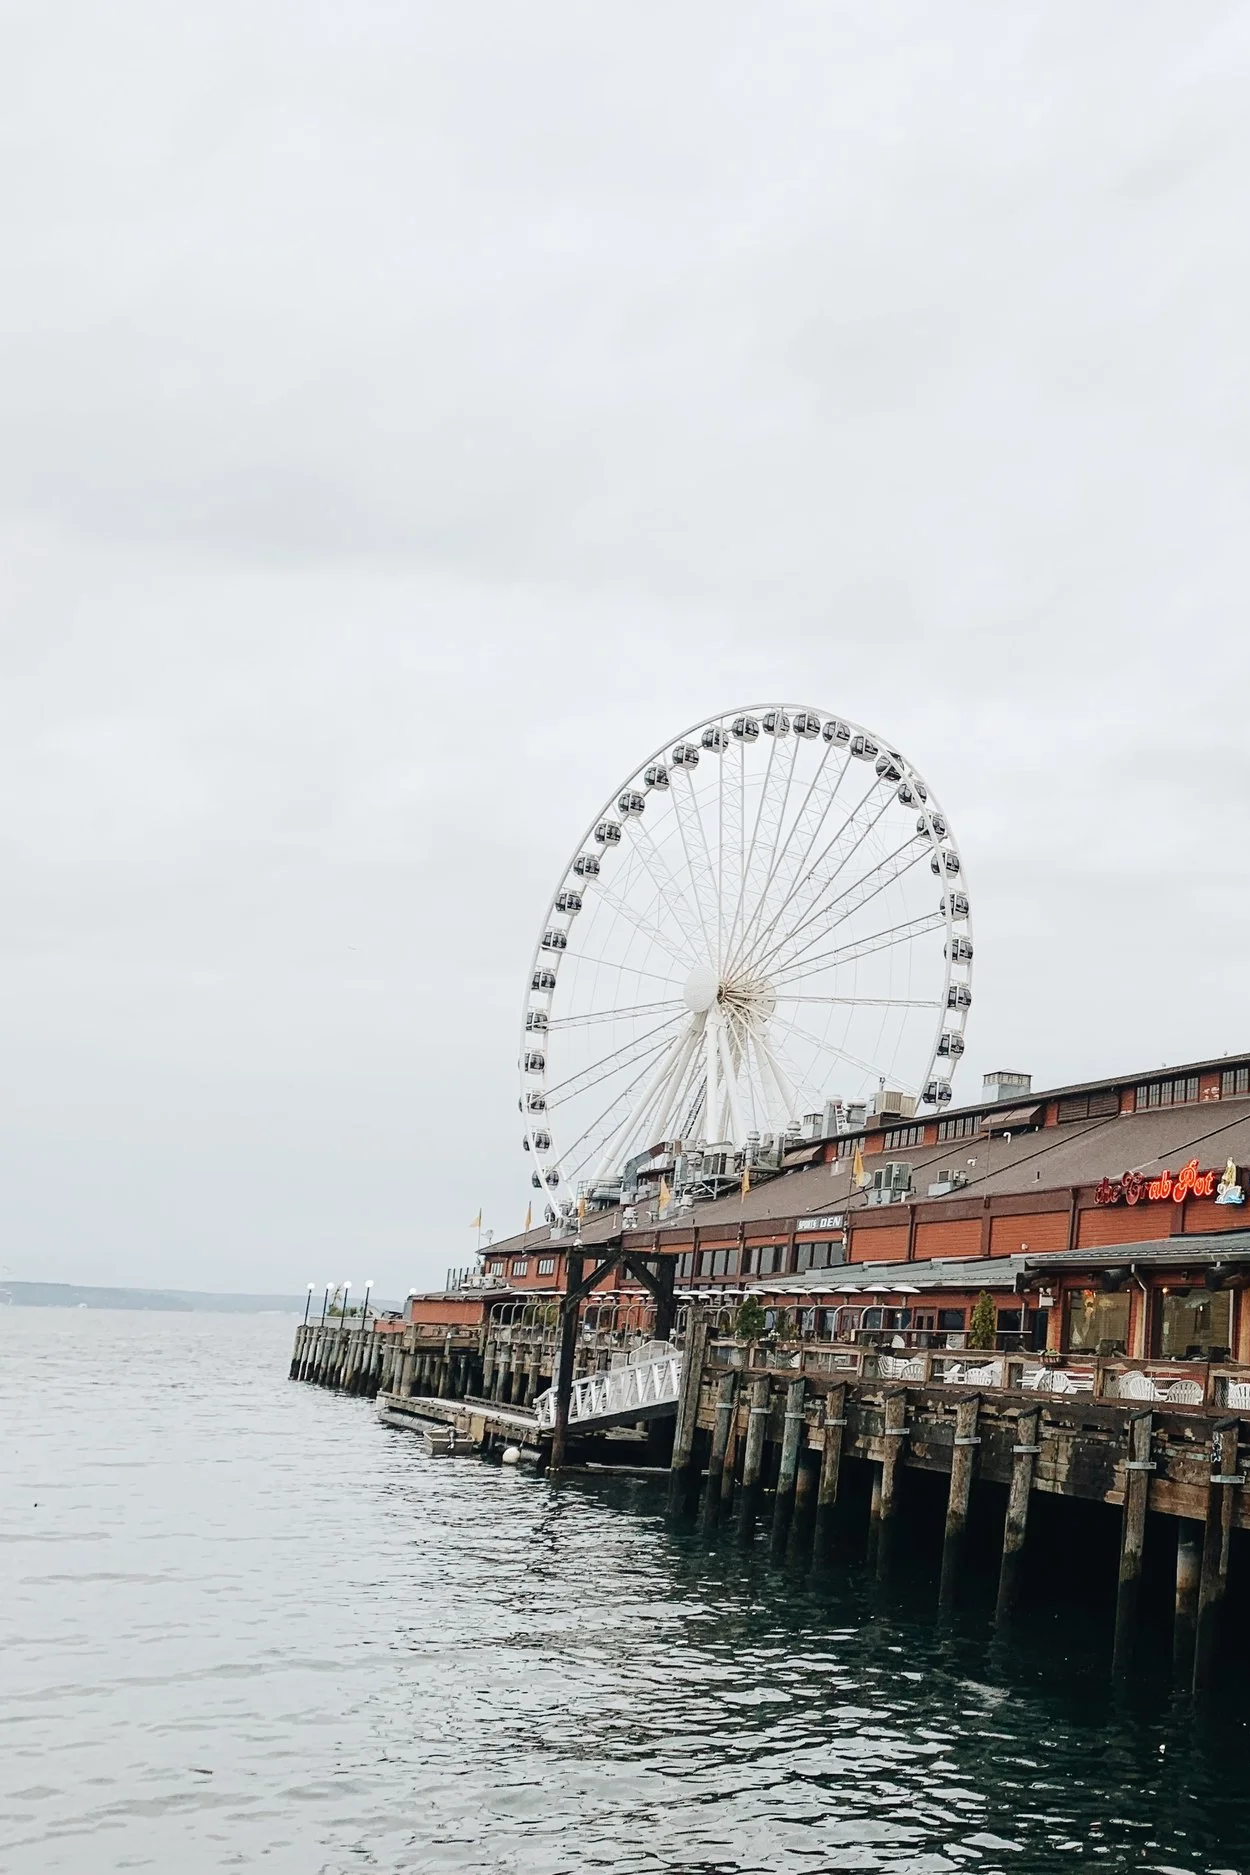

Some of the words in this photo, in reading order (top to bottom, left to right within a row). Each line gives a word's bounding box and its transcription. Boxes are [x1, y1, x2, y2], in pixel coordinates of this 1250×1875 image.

[1094, 1176, 1121, 1204] the
[1121, 1170, 1172, 1205] Crab
[1172, 1159, 1214, 1203] Pot
[820, 1216, 842, 1228] DEN
